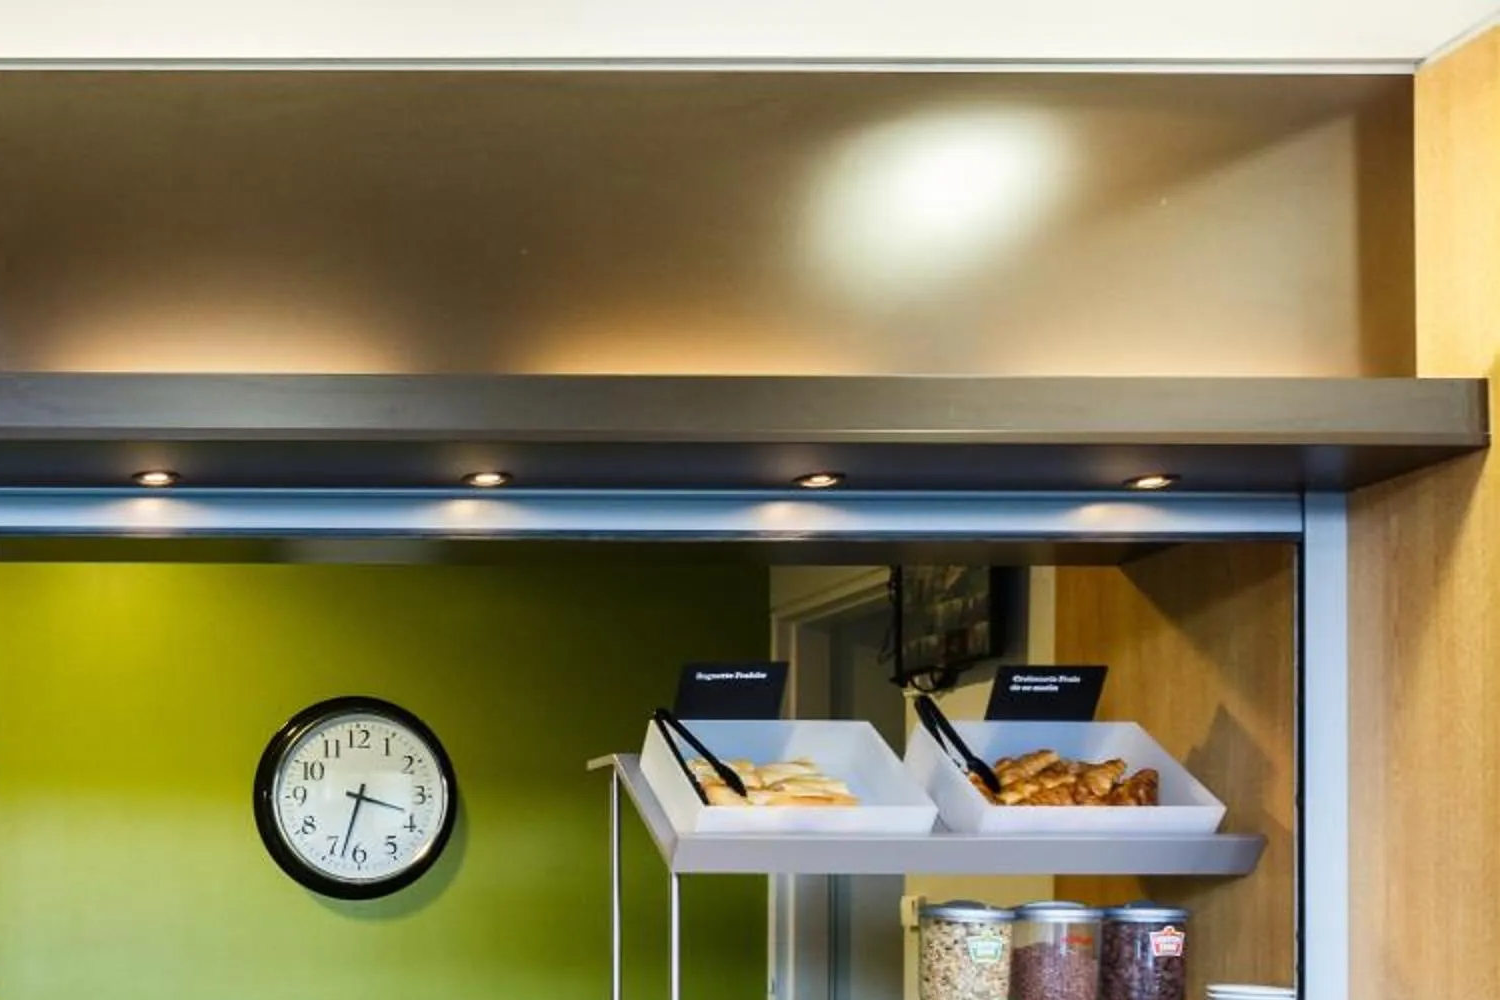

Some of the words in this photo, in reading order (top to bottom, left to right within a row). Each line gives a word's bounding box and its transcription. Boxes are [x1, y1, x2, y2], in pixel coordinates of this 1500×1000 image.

[323, 739, 341, 759] 11
[349, 729, 371, 749] 12
[384, 737, 391, 757] 1
[302, 761, 325, 781] 10
[402, 755, 416, 775] 2
[293, 786, 307, 806] 9
[412, 785, 427, 805] 3
[302, 815, 317, 835] 8
[403, 813, 417, 833] 4
[327, 835, 340, 857] 7
[351, 844, 367, 864] 6
[385, 835, 398, 856] 5
